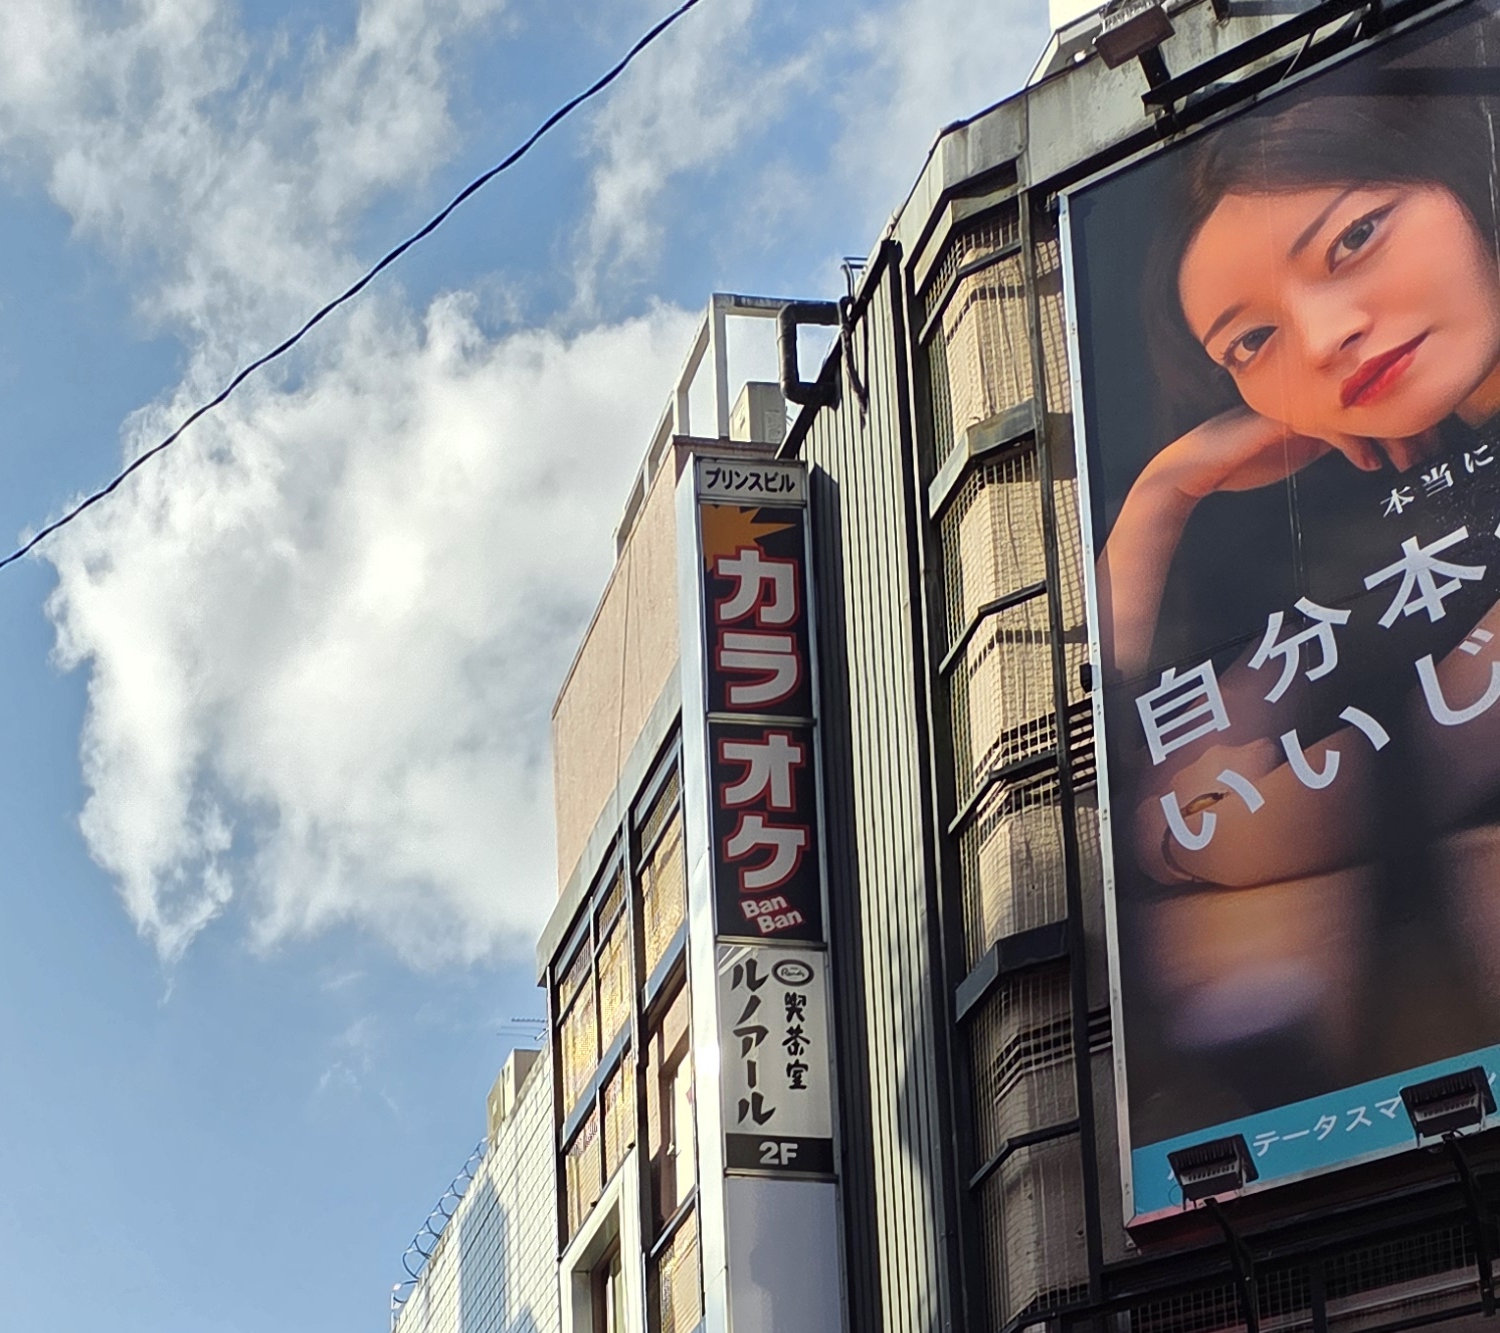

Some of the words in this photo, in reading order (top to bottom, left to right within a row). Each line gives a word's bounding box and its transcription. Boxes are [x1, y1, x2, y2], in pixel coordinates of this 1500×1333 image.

[705, 466, 796, 494] プリンスビル
[1380, 444, 1494, 518] 本当に
[1135, 524, 1500, 766] 自分本
[717, 548, 802, 889] カラオケ
[741, 896, 788, 920] Ban
[756, 908, 803, 935] Ban
[730, 957, 777, 1126] ルノアール
[781, 991, 812, 1090] 喫茶室
[758, 1141, 799, 1166] 2F
